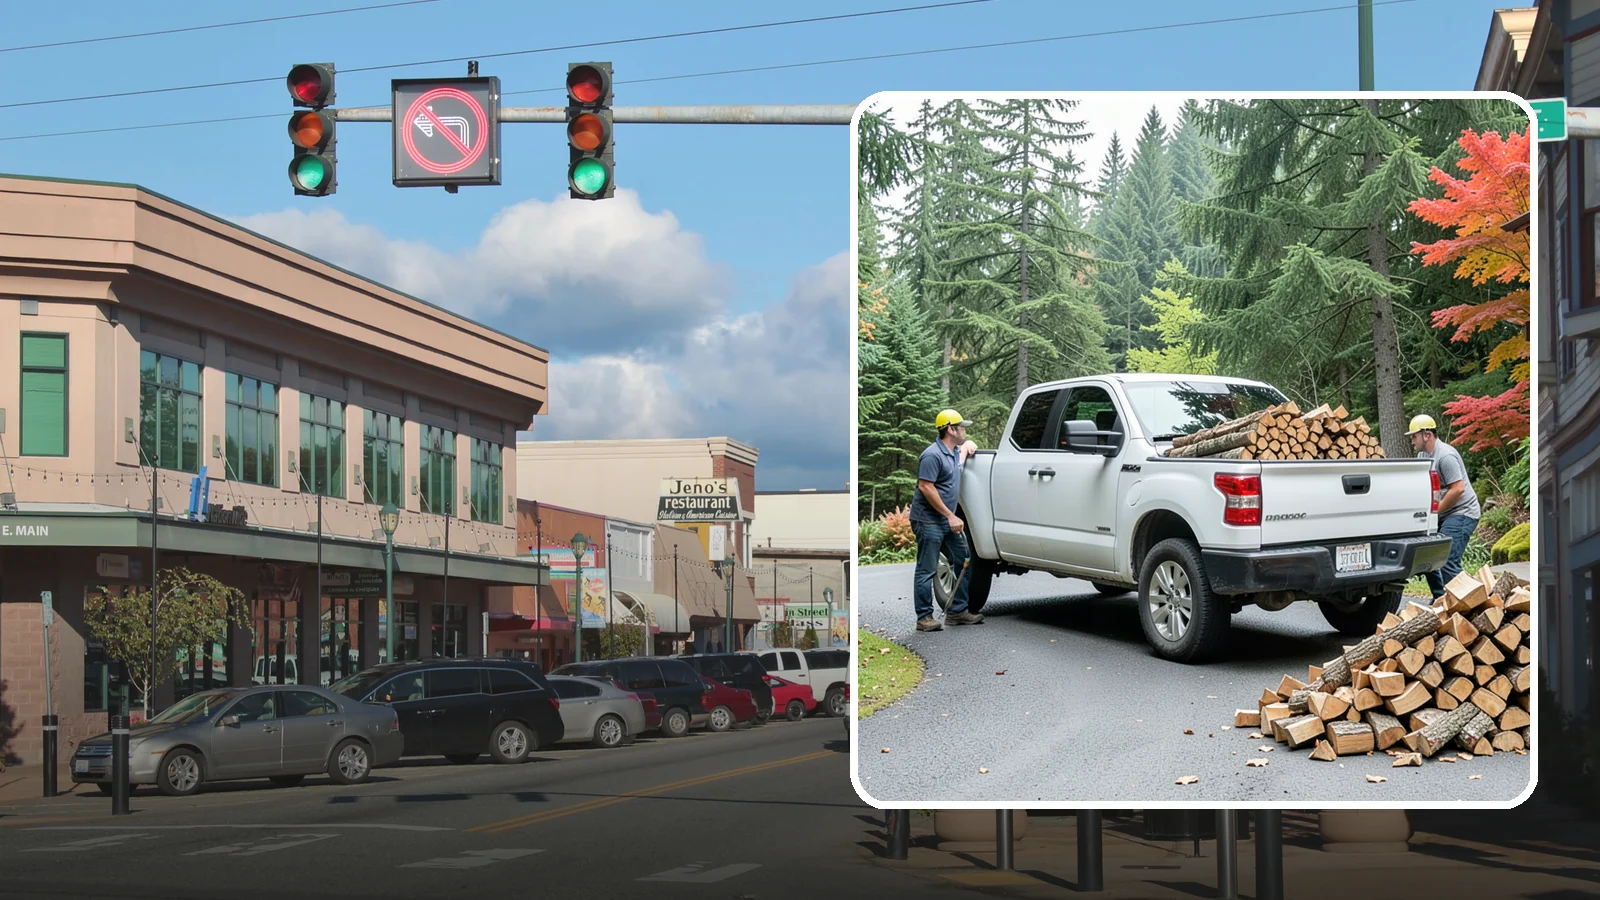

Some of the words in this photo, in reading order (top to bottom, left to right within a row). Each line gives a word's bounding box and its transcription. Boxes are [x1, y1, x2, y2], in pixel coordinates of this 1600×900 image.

[670, 480, 728, 495] Jeno's
[665, 496, 731, 509] restaurant
[658, 509, 682, 520] Italian
[686, 509, 715, 520] American
[715, 509, 737, 519] Cuisine
[2, 525, 13, 536] E.
[15, 525, 49, 536] MAIN
[798, 607, 829, 617] Street
